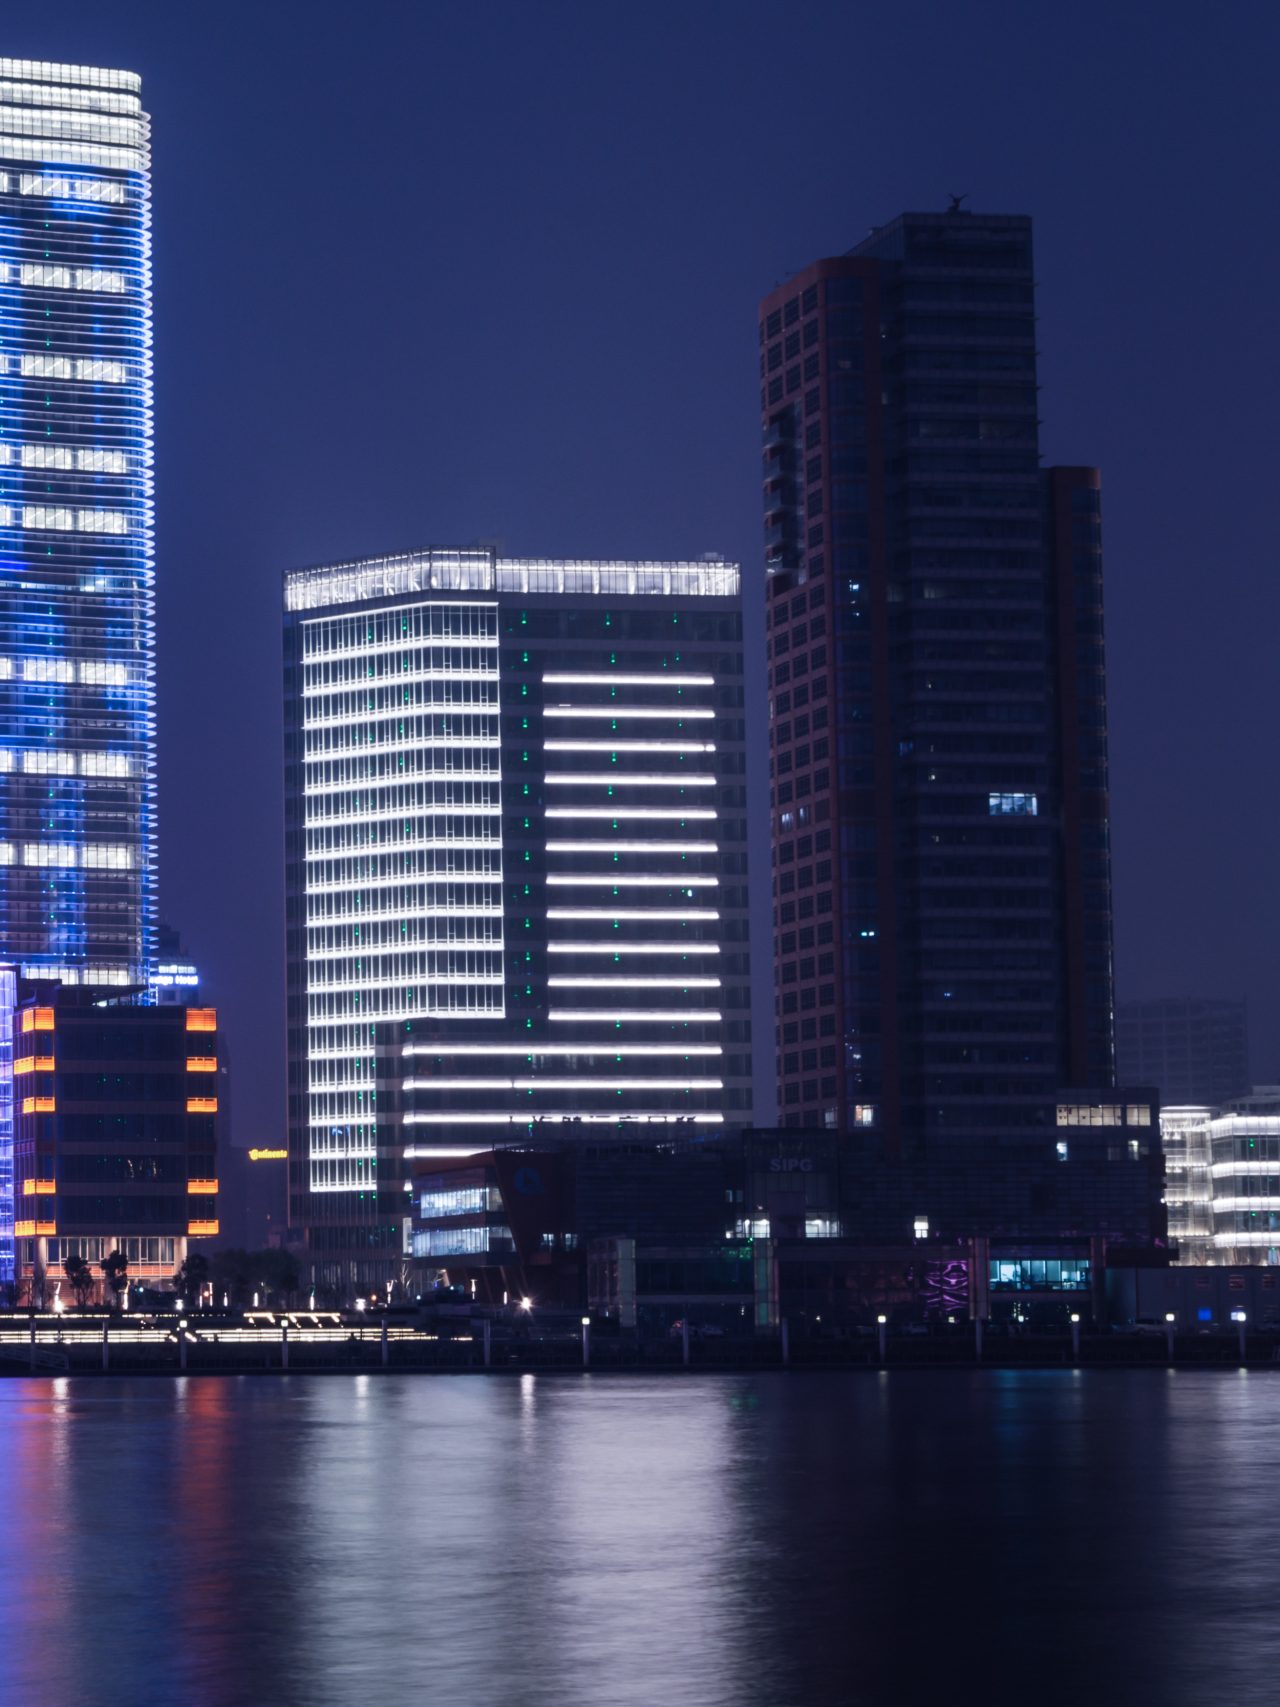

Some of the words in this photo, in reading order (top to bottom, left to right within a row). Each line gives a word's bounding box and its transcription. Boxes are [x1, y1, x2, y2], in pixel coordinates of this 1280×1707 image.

[175, 974, 198, 985] Hotel
[248, 1148, 288, 1160] Continenta
[769, 1158, 813, 1172] SIPG
